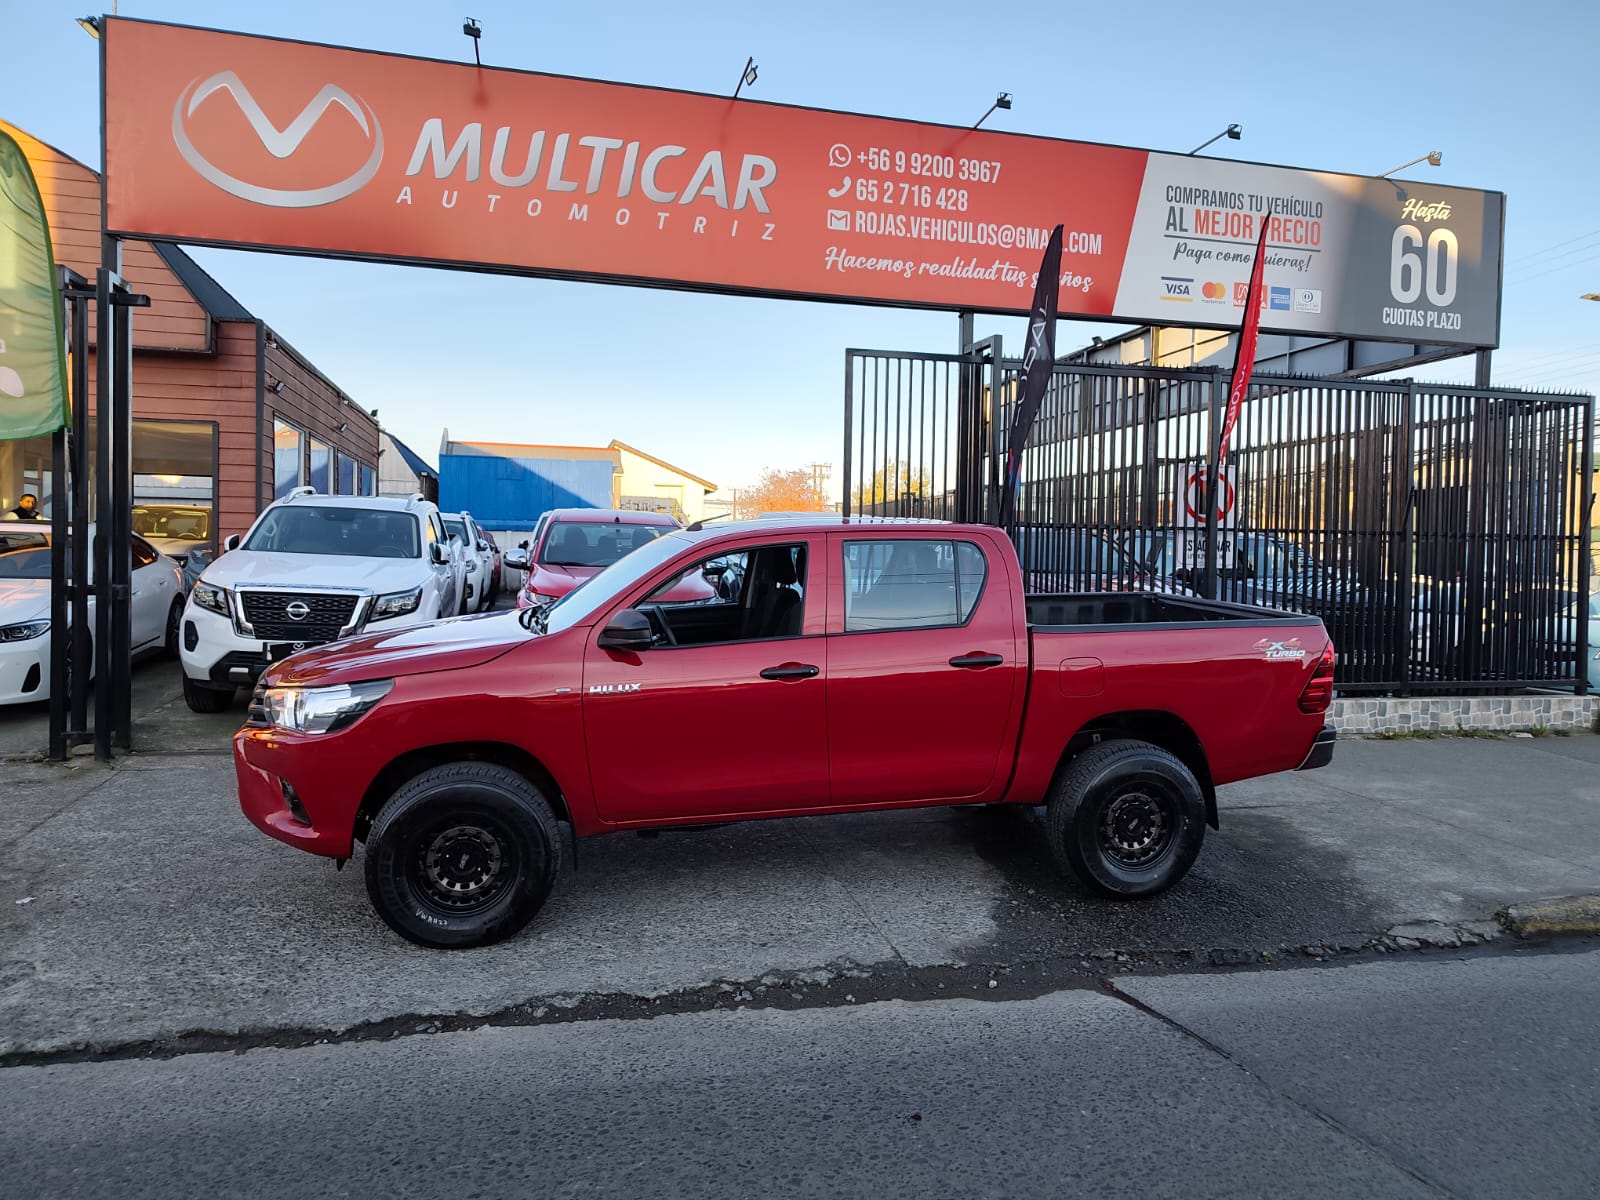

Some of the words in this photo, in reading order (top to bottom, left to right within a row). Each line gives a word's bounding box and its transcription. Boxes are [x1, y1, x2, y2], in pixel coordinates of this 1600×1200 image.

[405, 118, 778, 214] MULTICAR
[857, 147, 890, 171] +56
[895, 150, 906, 173] 9
[911, 152, 954, 179] 9200
[958, 158, 1001, 184] 3967
[856, 178, 878, 202] 65
[883, 181, 894, 204] 2
[899, 183, 931, 208] 716
[935, 187, 969, 212] 428
[1166, 185, 1245, 210] COMPRAMOS
[1248, 194, 1263, 213] TU
[1266, 194, 1323, 219] VEHÍCULO
[1401, 198, 1452, 222] Hasta
[396, 186, 775, 241] AUTOMOTRIZ
[1165, 206, 1189, 233] AL
[1194, 208, 1254, 240] MEJOR
[855, 210, 1102, 256] ROJAS.VEHICULOS@GMA.COM
[825, 246, 916, 279] Hacemos
[918, 256, 998, 281] realidad
[998, 261, 1028, 287] tus
[1030, 270, 1094, 293] sños
[1173, 242, 1213, 264] Paga
[1215, 249, 1251, 264] como
[1263, 252, 1313, 273] uieras!
[1390, 224, 1459, 307] 60
[1165, 283, 1190, 296] VISA
[1382, 307, 1425, 327] CUOTAS
[1427, 311, 1461, 331] PLAZO
[1265, 650, 1306, 658] TURBO
[589, 682, 641, 695] HILUX
